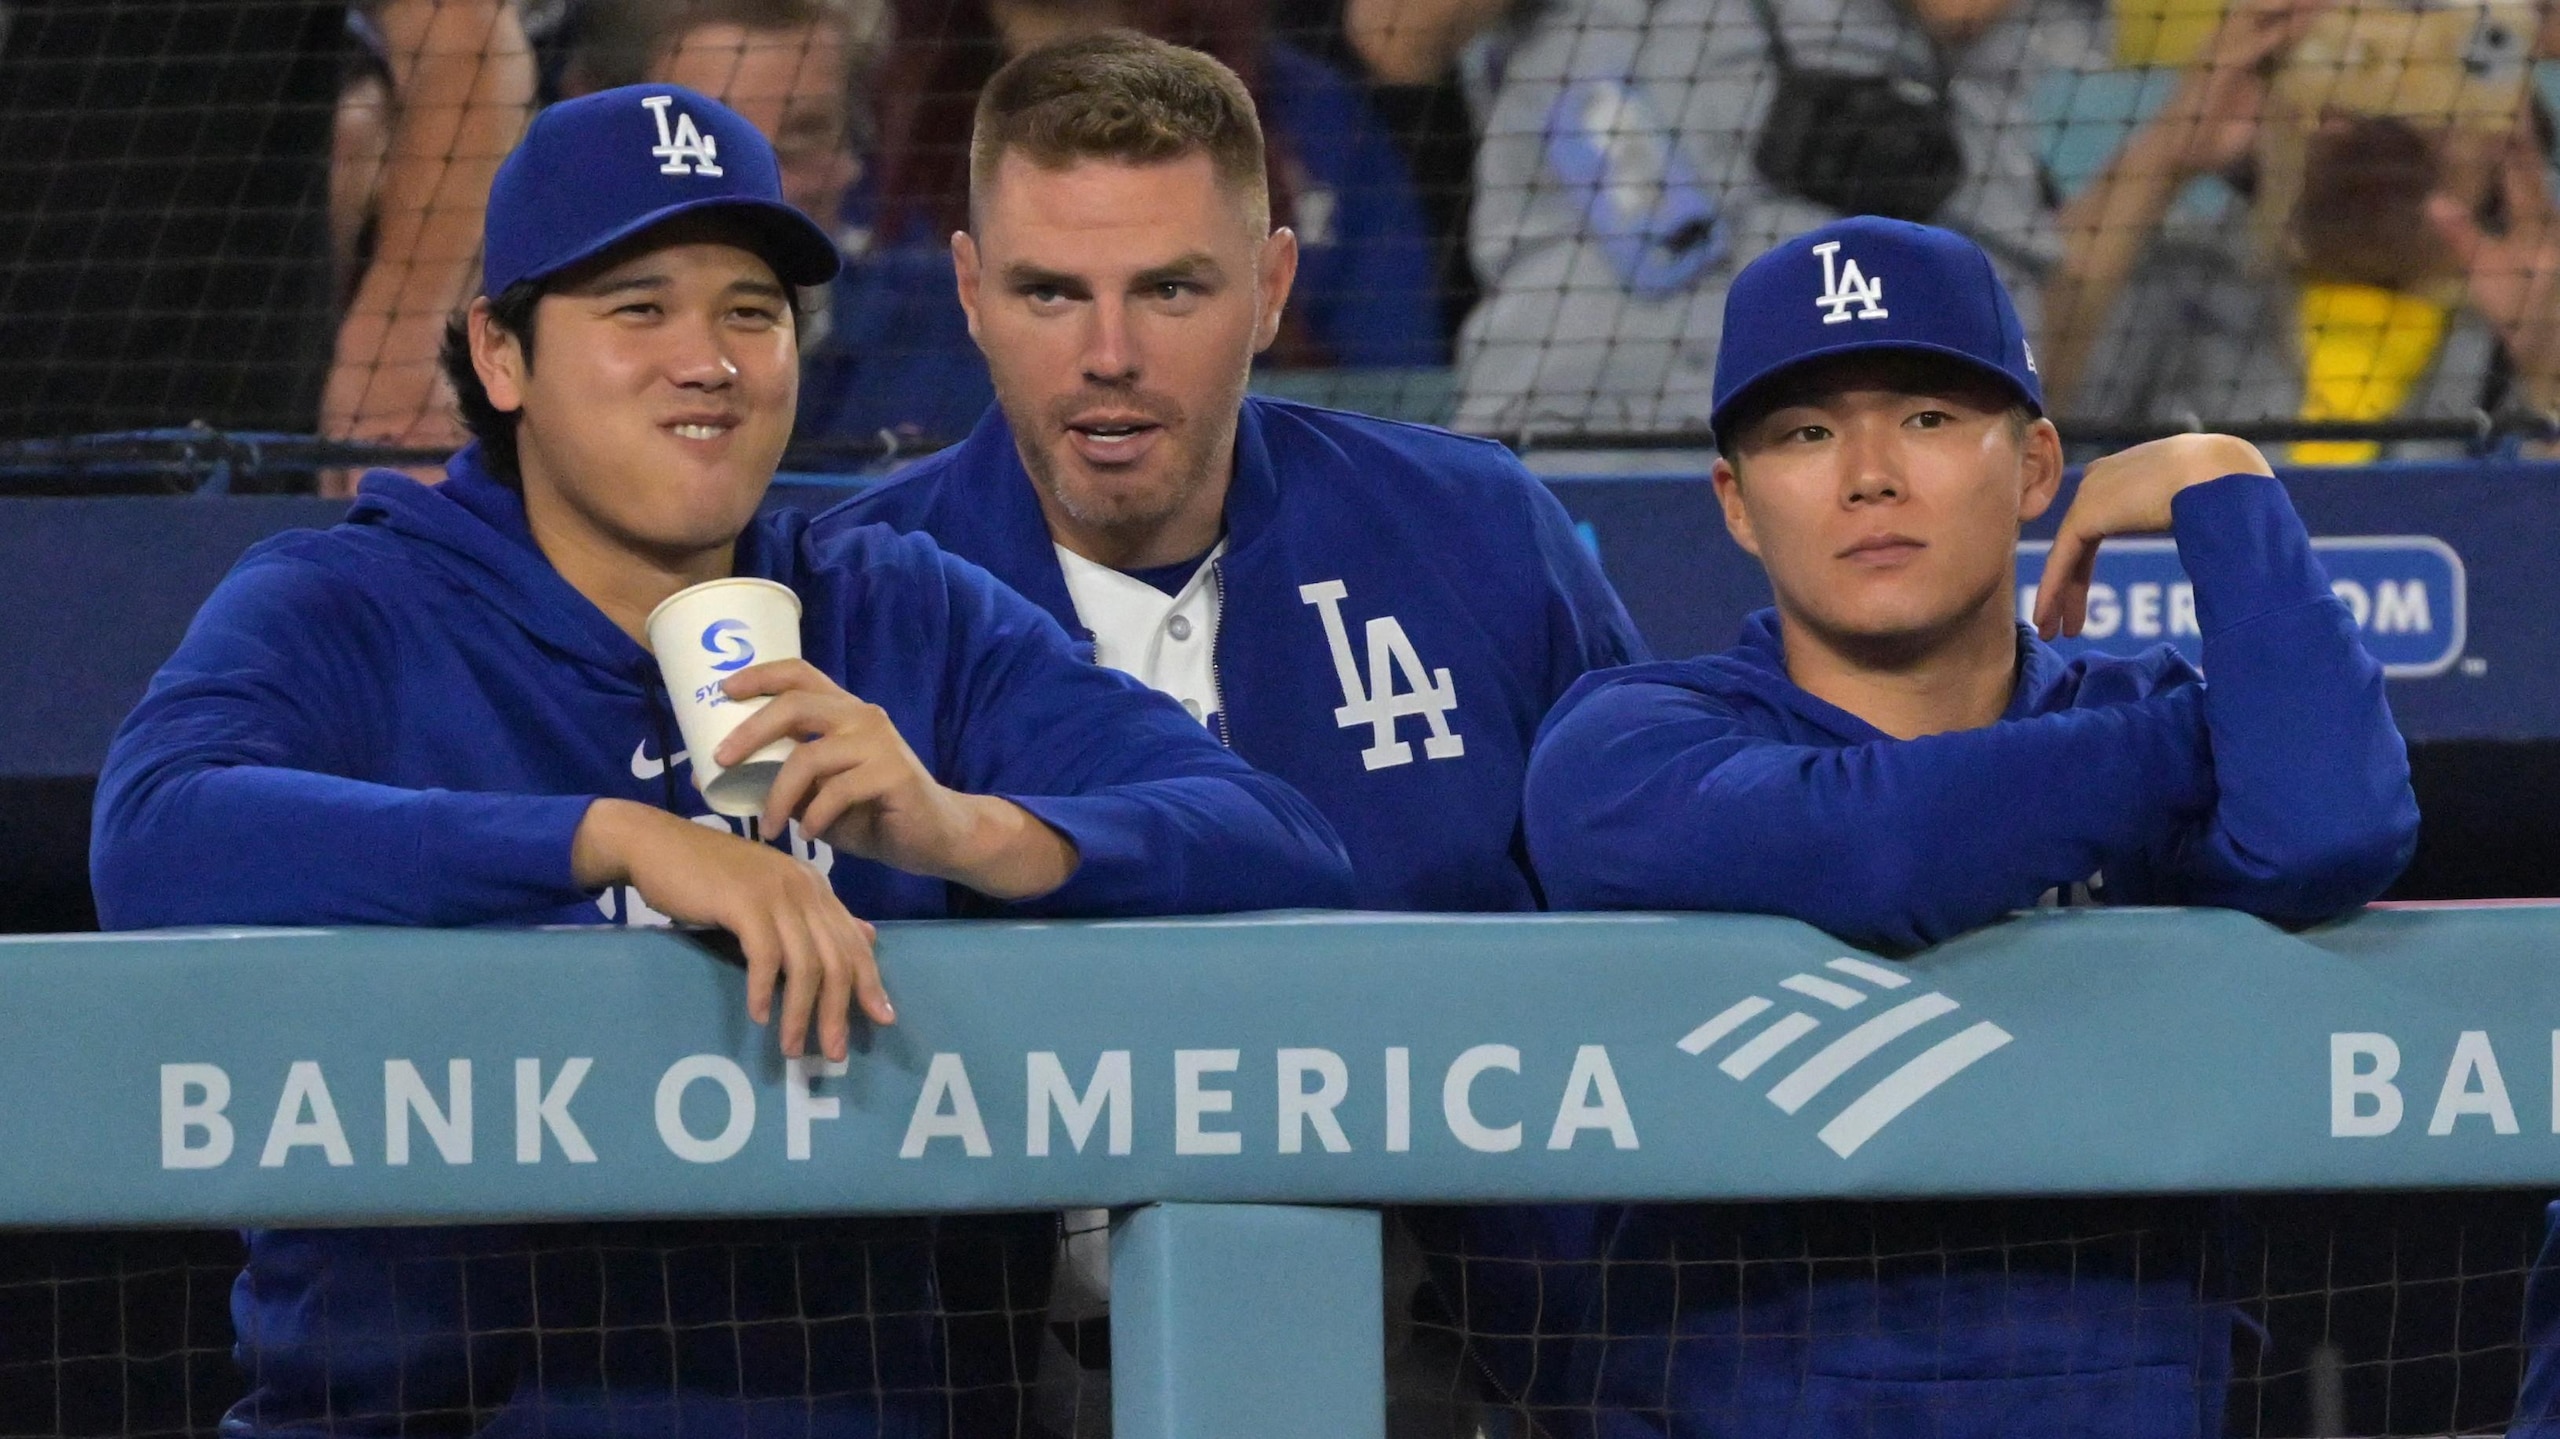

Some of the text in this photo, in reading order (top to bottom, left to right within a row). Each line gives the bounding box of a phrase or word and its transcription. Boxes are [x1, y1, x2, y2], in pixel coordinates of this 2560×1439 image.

[641, 95, 723, 177] LA
[1812, 241, 1888, 324] LA
[1299, 579, 1465, 771] LA
[160, 1044, 1640, 1168] BANK OF AMERICA
[2330, 1030, 2560, 1138] BA
